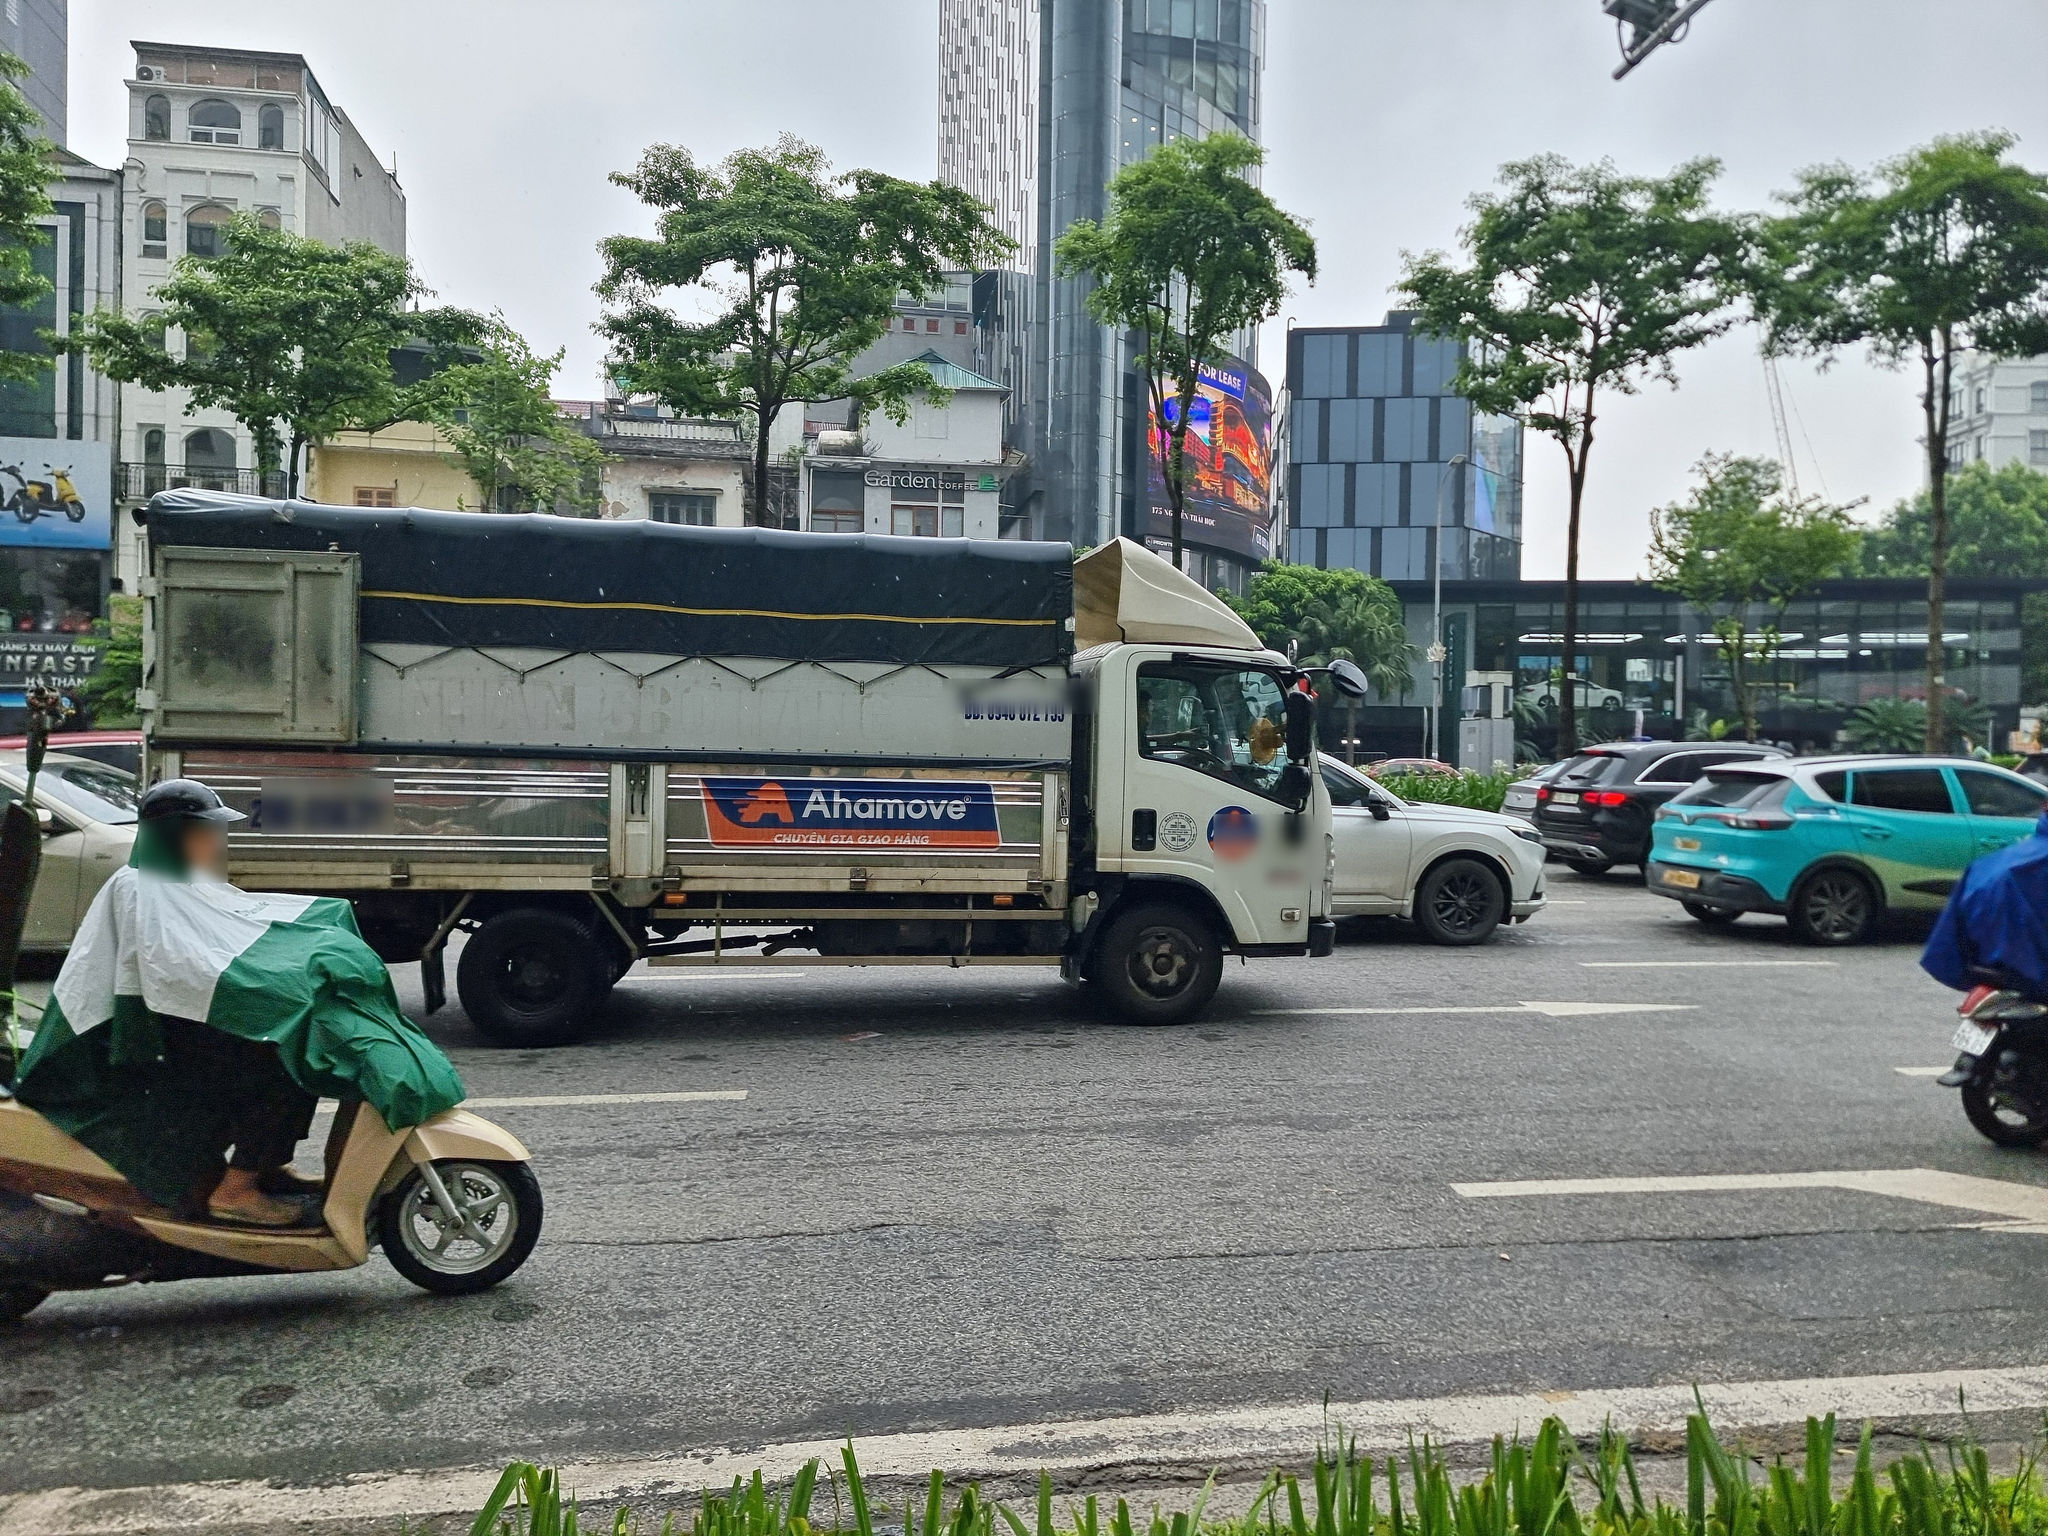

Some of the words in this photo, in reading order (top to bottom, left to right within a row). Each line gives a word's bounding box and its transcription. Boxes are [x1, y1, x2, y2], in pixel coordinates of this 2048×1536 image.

[1198, 362, 1217, 380] FOR
[1218, 369, 1241, 391] LEASE
[864, 469, 937, 489] Garden
[938, 482, 976, 491] COFFEE
[1151, 506, 1163, 515] 175
[29, 643, 43, 652] XE
[0, 654, 95, 673] NFAST
[773, 831, 827, 844] CHUYÊN
[830, 833, 854, 844] GIA
[857, 834, 891, 844] GIAO
[894, 832, 929, 845] HÀNG
